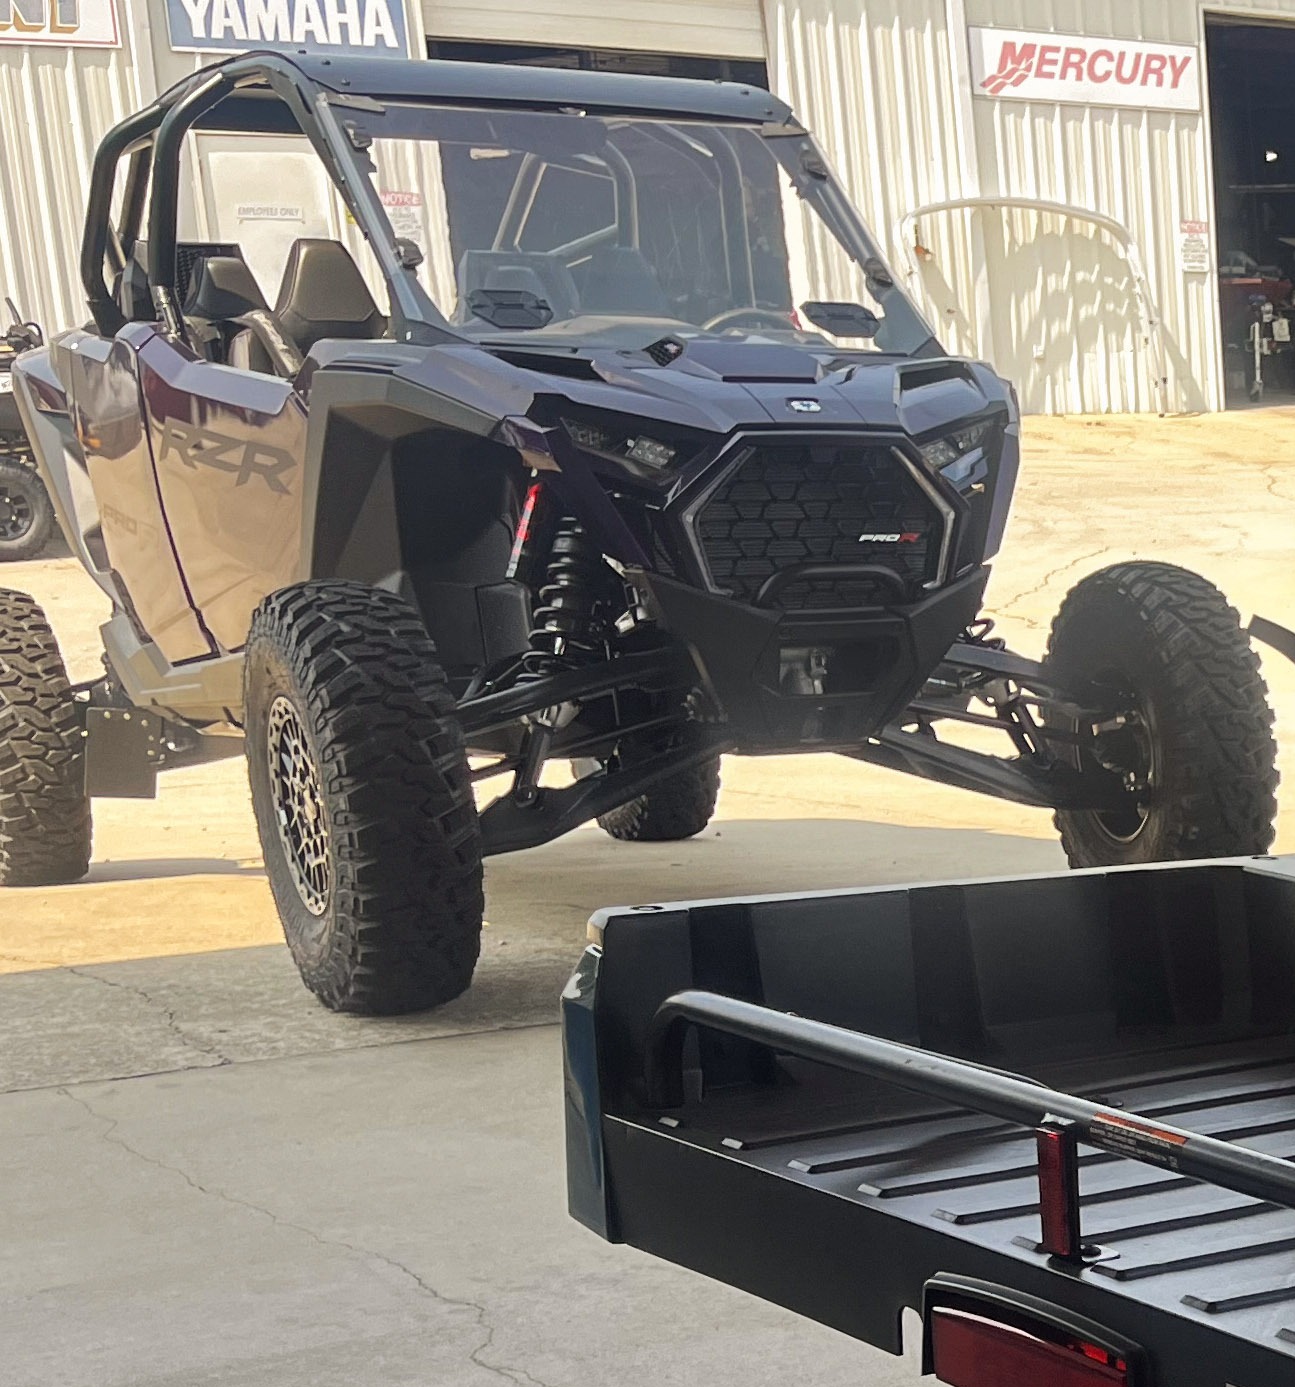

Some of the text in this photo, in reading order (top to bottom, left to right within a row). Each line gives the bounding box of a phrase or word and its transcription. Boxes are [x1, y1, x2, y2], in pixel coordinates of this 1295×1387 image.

[180, 0, 399, 48] YAMAHA
[981, 41, 1192, 94] MERCURY
[238, 206, 300, 217] EMPLOYEES ONLY
[159, 416, 298, 496] RZR
